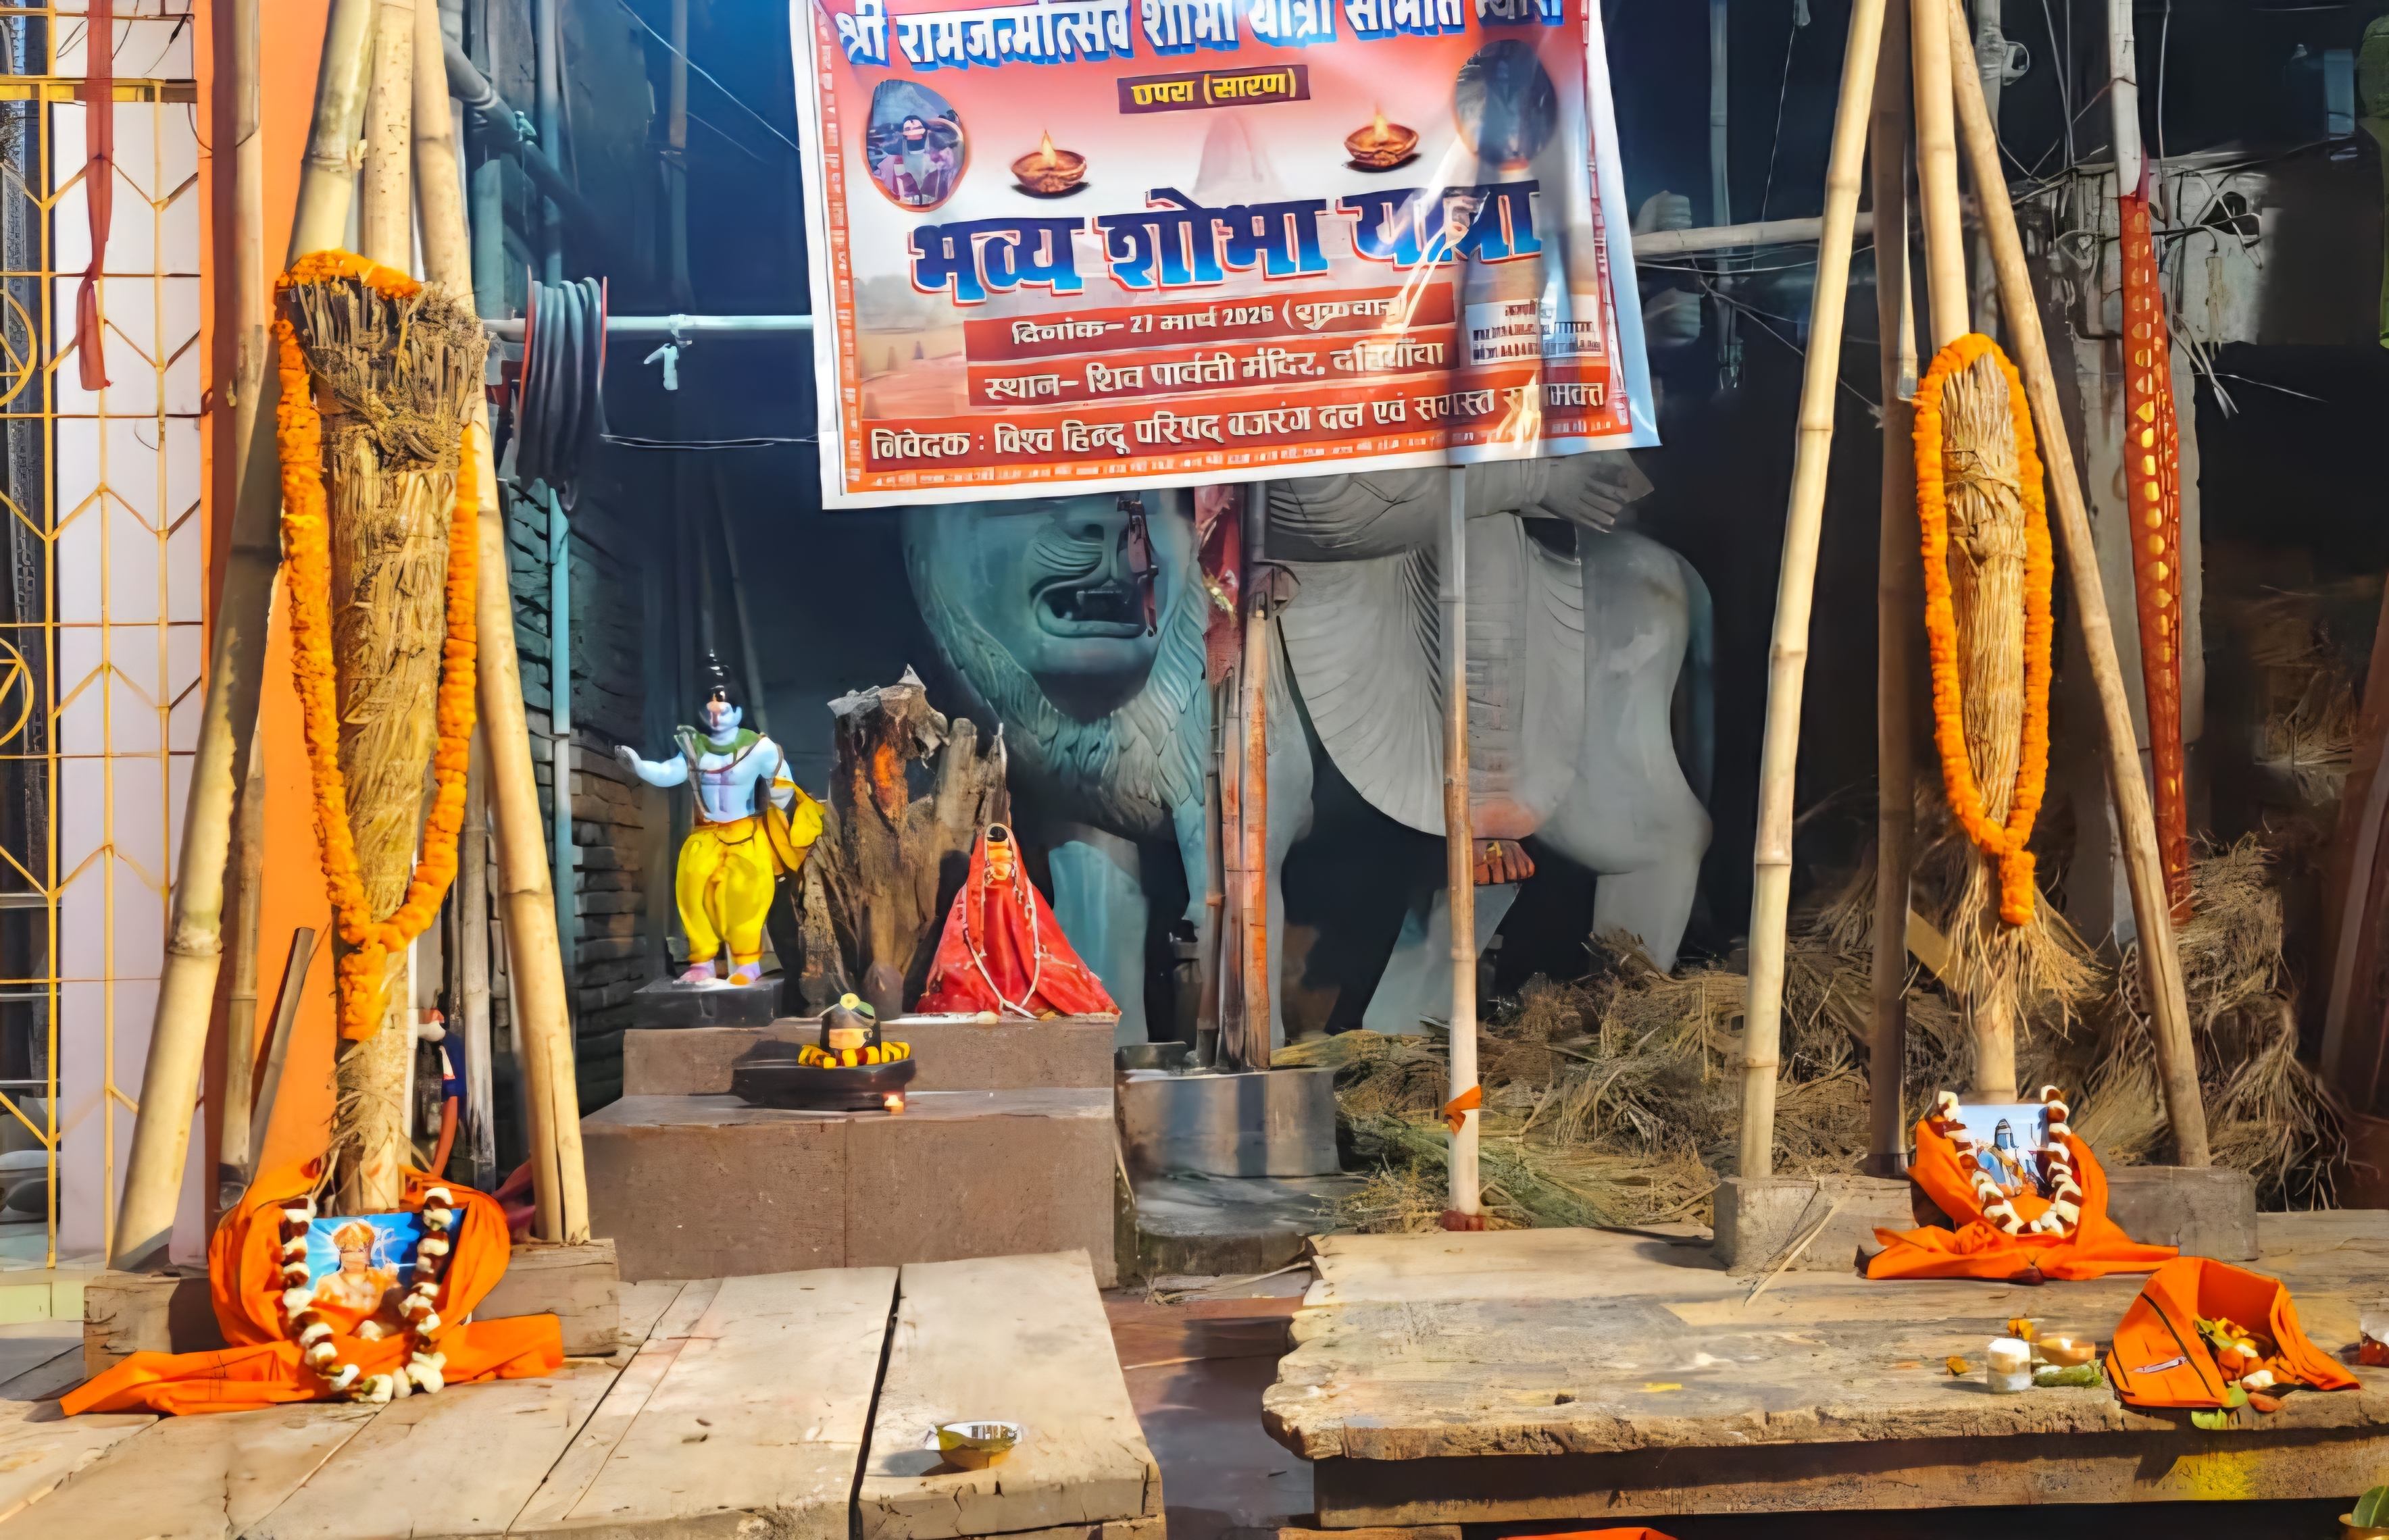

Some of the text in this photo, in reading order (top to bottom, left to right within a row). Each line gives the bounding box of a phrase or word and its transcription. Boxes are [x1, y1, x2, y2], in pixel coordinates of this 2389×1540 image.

[834, 0, 890, 66] श्री
[1203, 67, 1297, 105] (सारण)
[907, 217, 1084, 306] भव्य
[1092, 186, 1328, 291] शोभा
[1223, 306, 1274, 326] 2026
[1086, 362, 1144, 393] शिव
[1151, 351, 1236, 385] पार्वती
[994, 422, 1055, 455] विश्व
[1061, 419, 1131, 455] हिन्दू
[1316, 402, 1364, 430] दल
[1371, 392, 1407, 424] एवं
